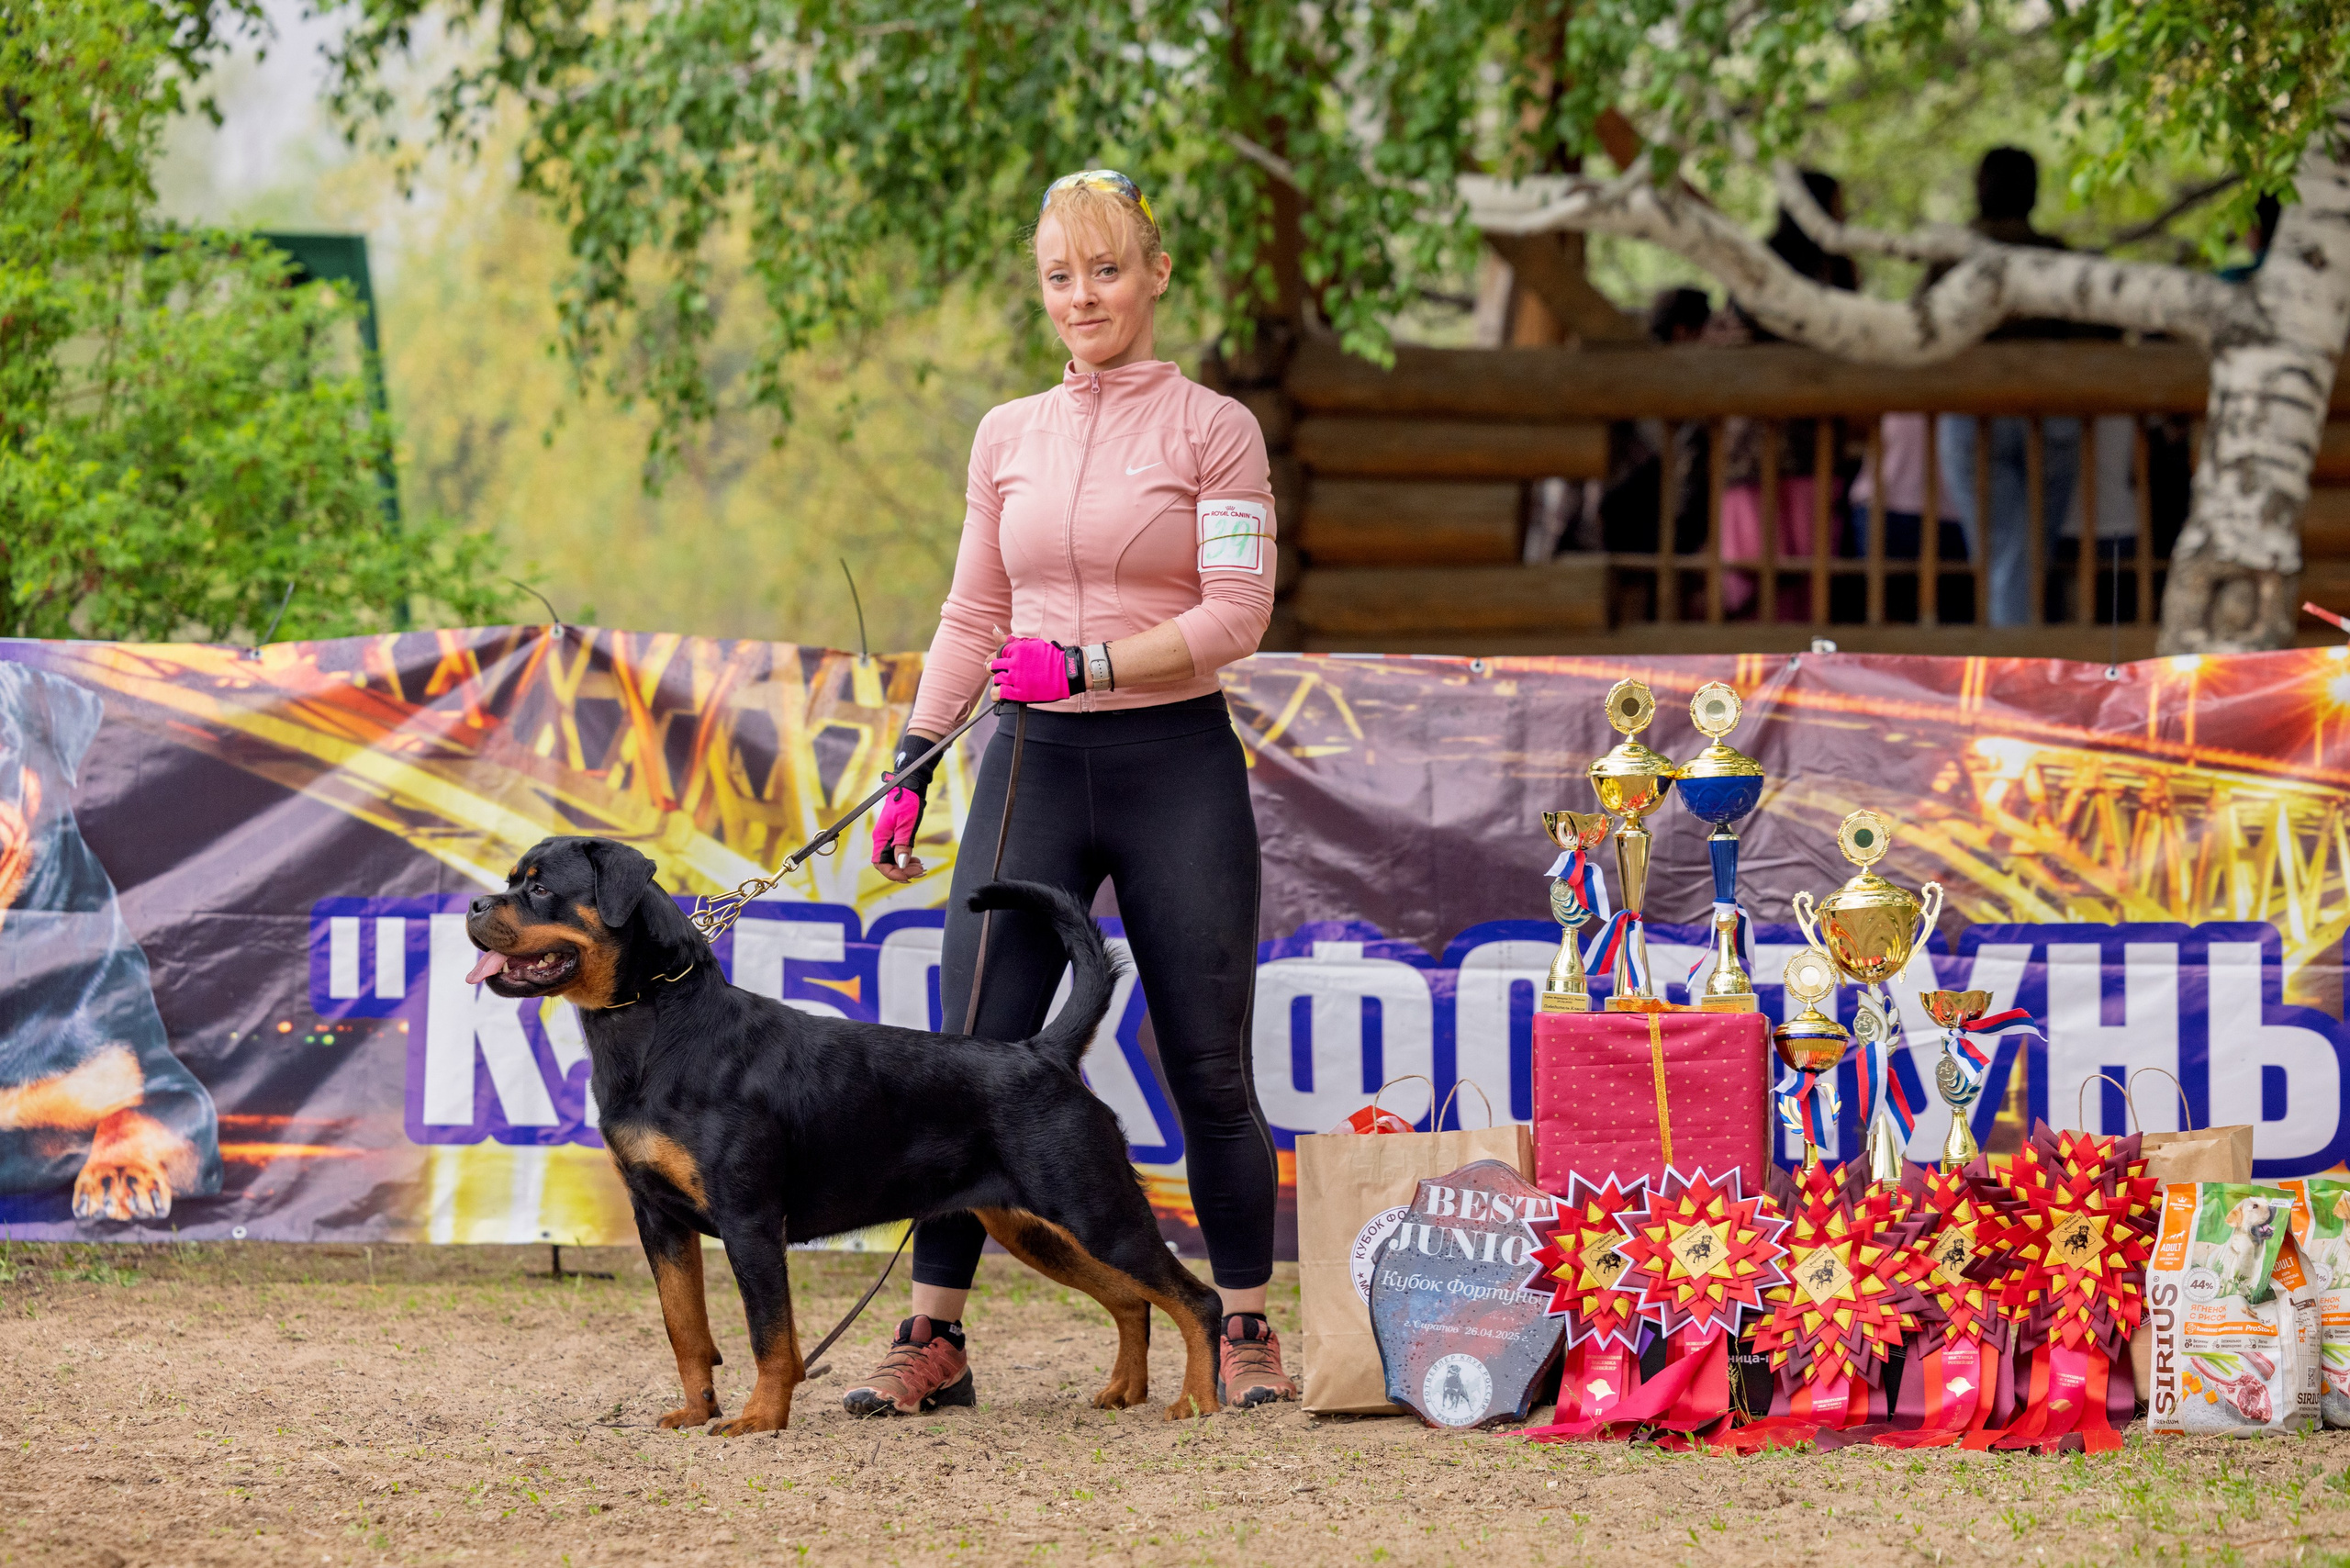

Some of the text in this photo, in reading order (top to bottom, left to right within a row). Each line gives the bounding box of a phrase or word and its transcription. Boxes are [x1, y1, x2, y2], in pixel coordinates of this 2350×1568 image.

[1423, 1184, 1550, 1225] BEST
[1355, 1210, 1406, 1260] КУБОК ФО
[1388, 1222, 1533, 1267] JUNIO
[2160, 1242, 2183, 1252] ADULT
[1381, 1270, 1543, 1305] Кубок Фортуны
[2190, 1279, 2214, 1290] 44%
[2190, 1304, 2227, 1314] ЯГНЕНОК
[2198, 1313, 2226, 1322] РИСОМ
[1413, 1319, 1460, 1334] Саратов
[1464, 1327, 1521, 1341] 26.04.2025
[2152, 1282, 2178, 1415] SIRIUS
[1460, 1355, 1483, 1370] КЛУБ
[1481, 1371, 1492, 1410] РОССИИ
